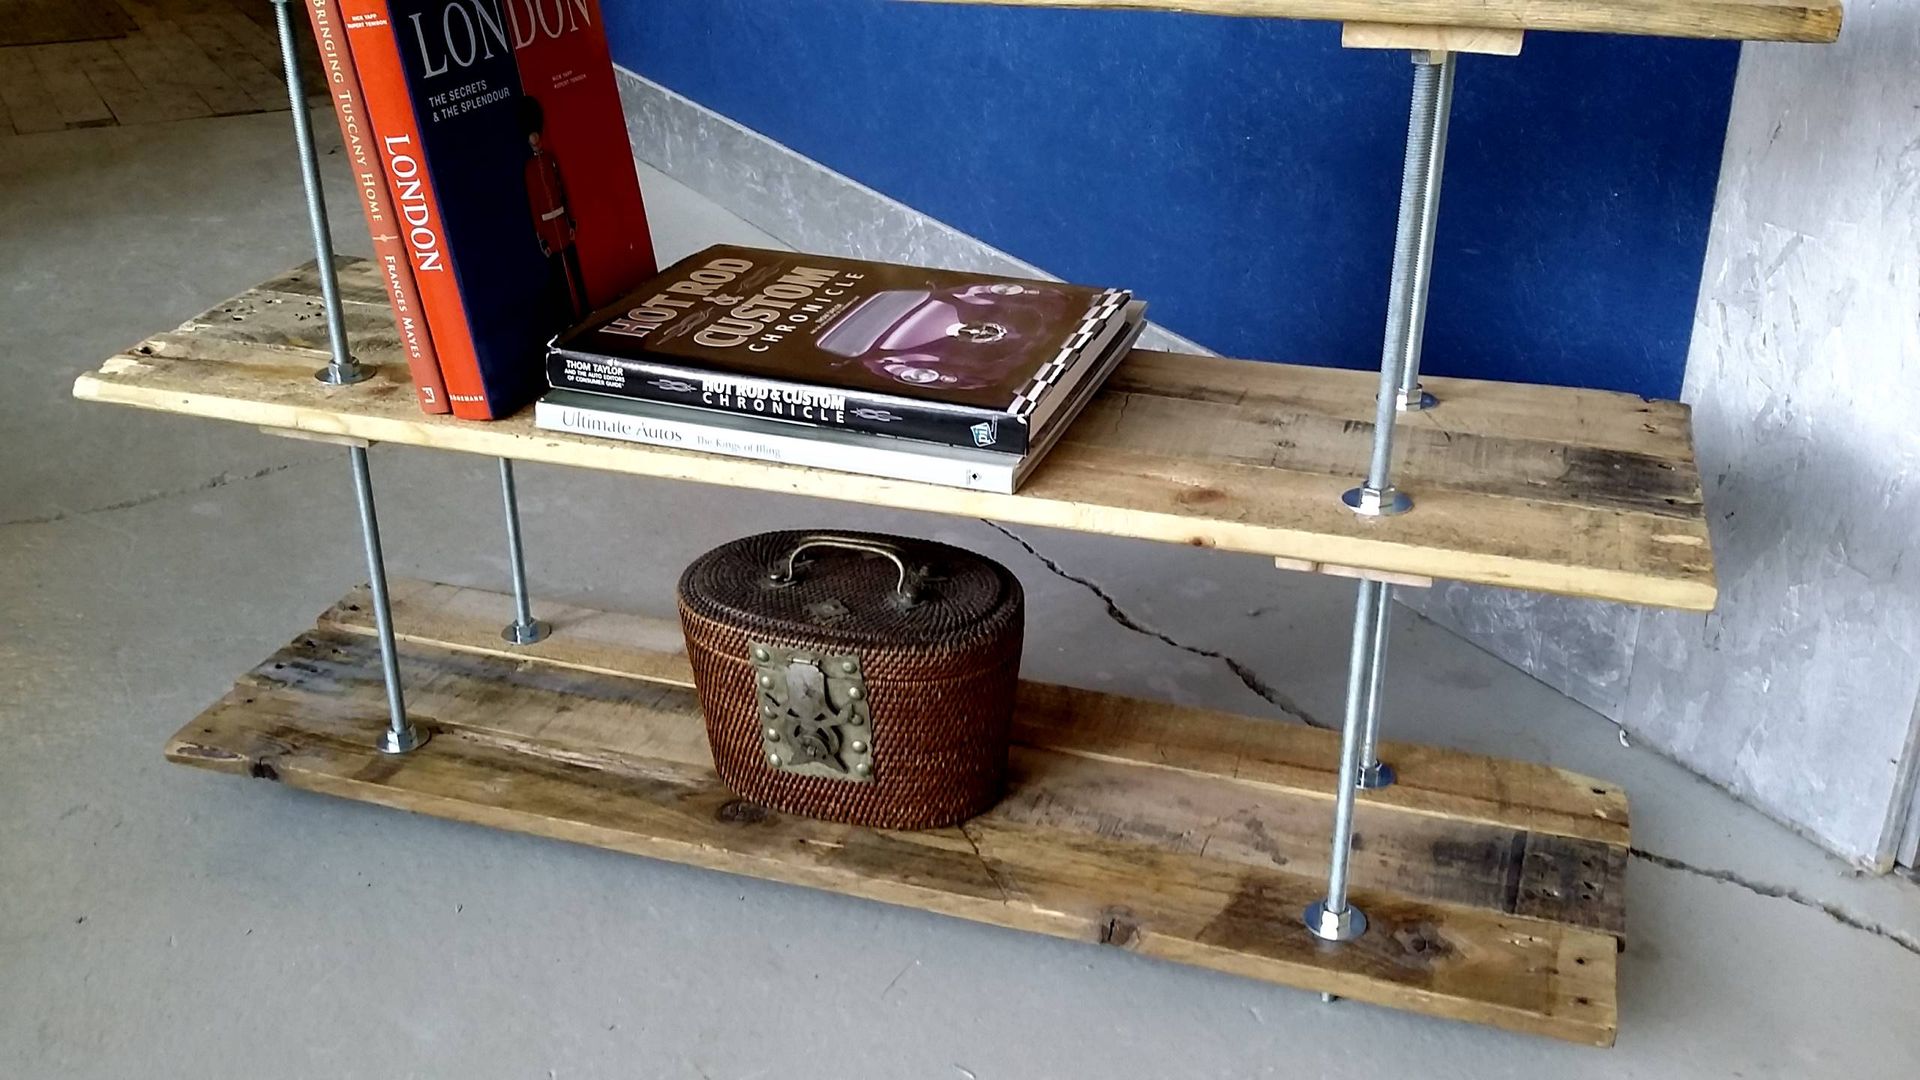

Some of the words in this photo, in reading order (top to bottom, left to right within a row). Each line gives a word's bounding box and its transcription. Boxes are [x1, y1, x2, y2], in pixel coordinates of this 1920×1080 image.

[313, 0, 344, 84] BRINGING
[338, 90, 368, 166] TUSCANY
[360, 173, 383, 222] HOME
[429, 92, 448, 108] THE
[449, 79, 488, 101] SECRETS
[433, 112, 440, 123] &
[441, 105, 460, 120] THE
[460, 86, 511, 113] SPLENDOUR
[384, 133, 444, 272] LONDON
[384, 255, 408, 313] FRANCES
[402, 317, 421, 359] MAYES
[599, 293, 695, 338] HOT
[666, 258, 754, 296] ROD
[693, 265, 840, 348] CUSTOM
[748, 271, 865, 353] CHRONICLE
[566, 359, 591, 371] THOM
[592, 363, 624, 376] TAYLOR
[702, 380, 734, 395] HOT
[735, 384, 769, 400] ROD
[782, 390, 846, 411] CUSTOM
[702, 391, 845, 424] CHRONICLE
[562, 410, 632, 436] Ultimate
[636, 421, 682, 442] Autos
[697, 435, 712, 446] The
[716, 439, 741, 452] Kings
[743, 443, 753, 452] of
[756, 444, 781, 458] Bling
